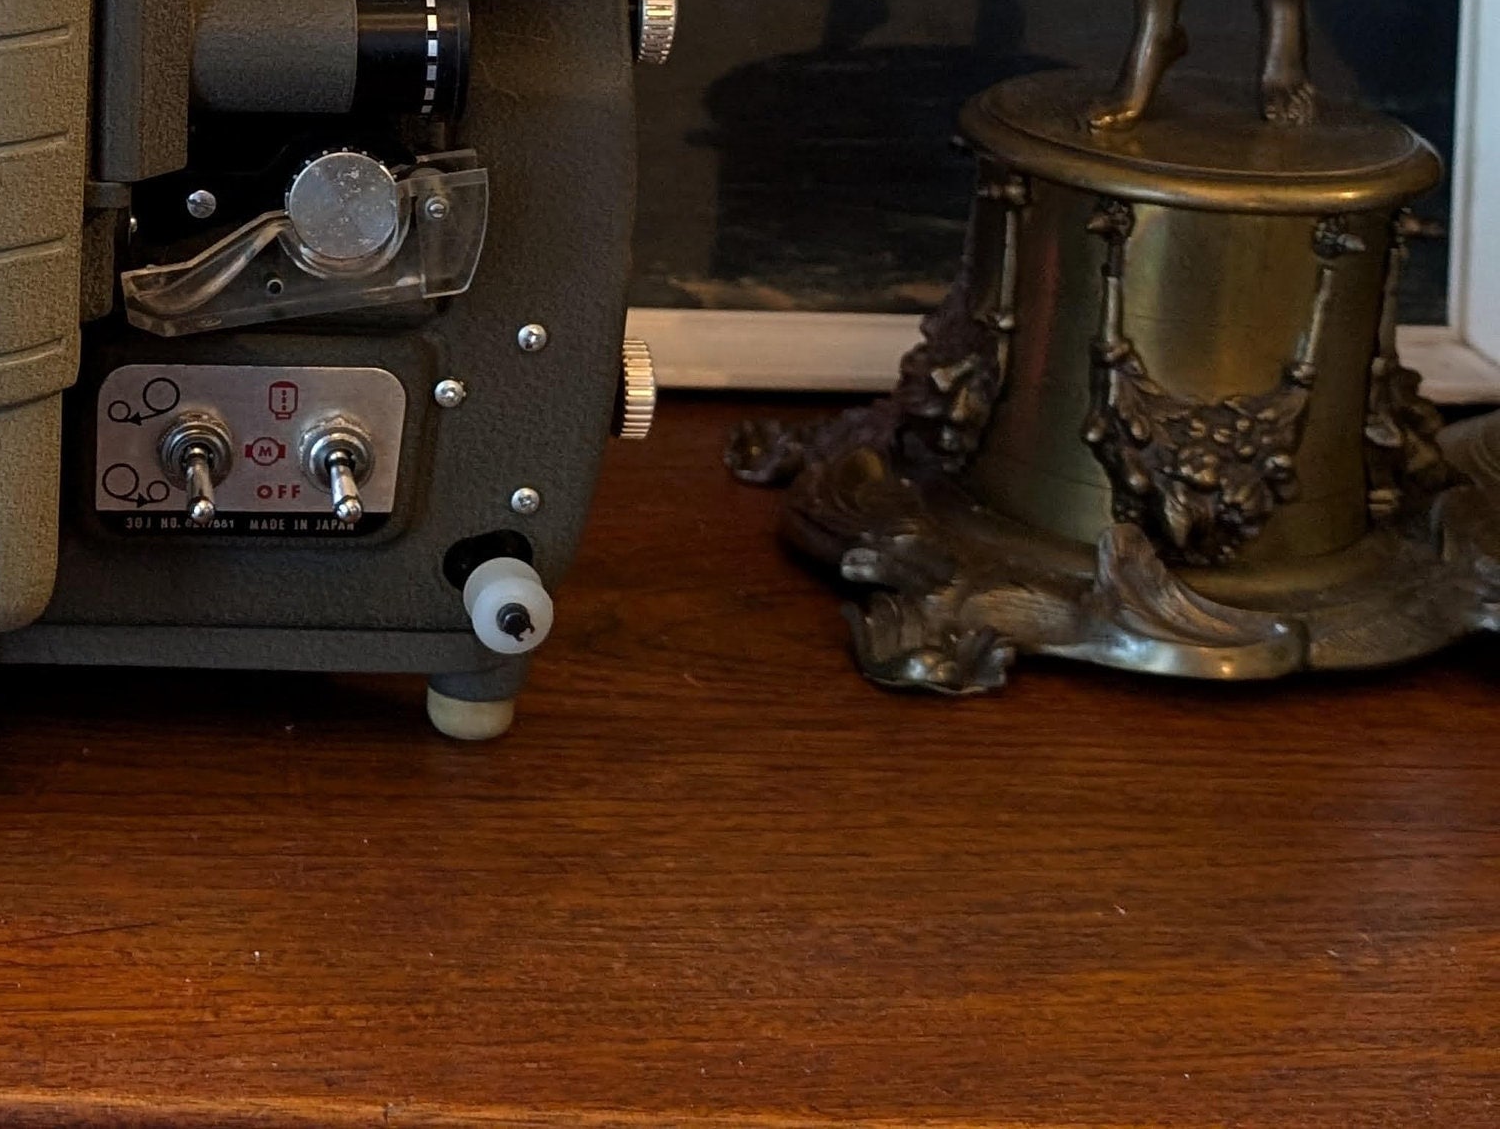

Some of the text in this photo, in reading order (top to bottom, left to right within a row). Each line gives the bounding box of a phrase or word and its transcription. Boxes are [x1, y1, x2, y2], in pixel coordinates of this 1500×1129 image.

[258, 445, 273, 458] M
[256, 483, 302, 500] OFF
[249, 517, 355, 531] MADE IN JAPAN
